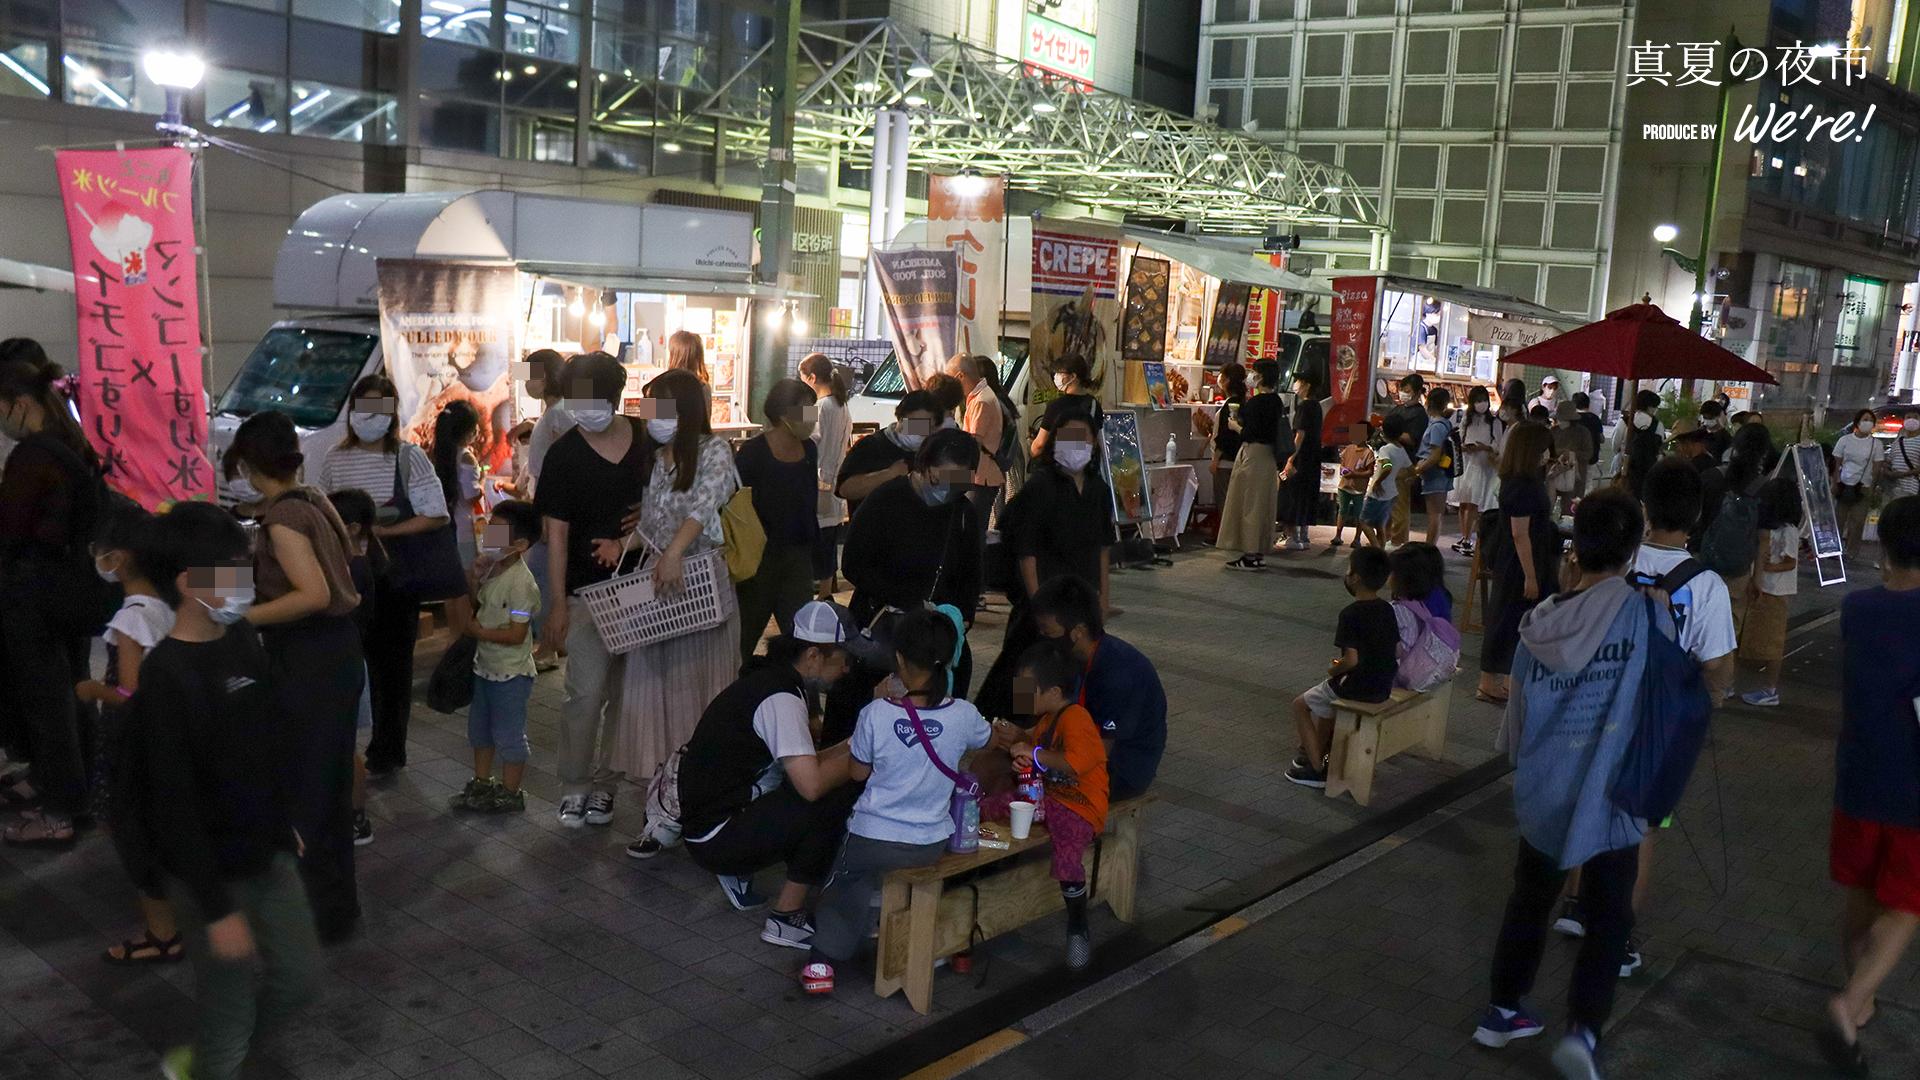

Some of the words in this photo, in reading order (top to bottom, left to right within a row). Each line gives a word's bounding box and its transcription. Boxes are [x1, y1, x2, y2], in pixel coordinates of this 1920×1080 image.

[791, 232, 833, 253] 区役所
[1039, 240, 1110, 277] CREPE
[1490, 325, 1513, 341] Pizza
[1517, 328, 1538, 344] Truck
